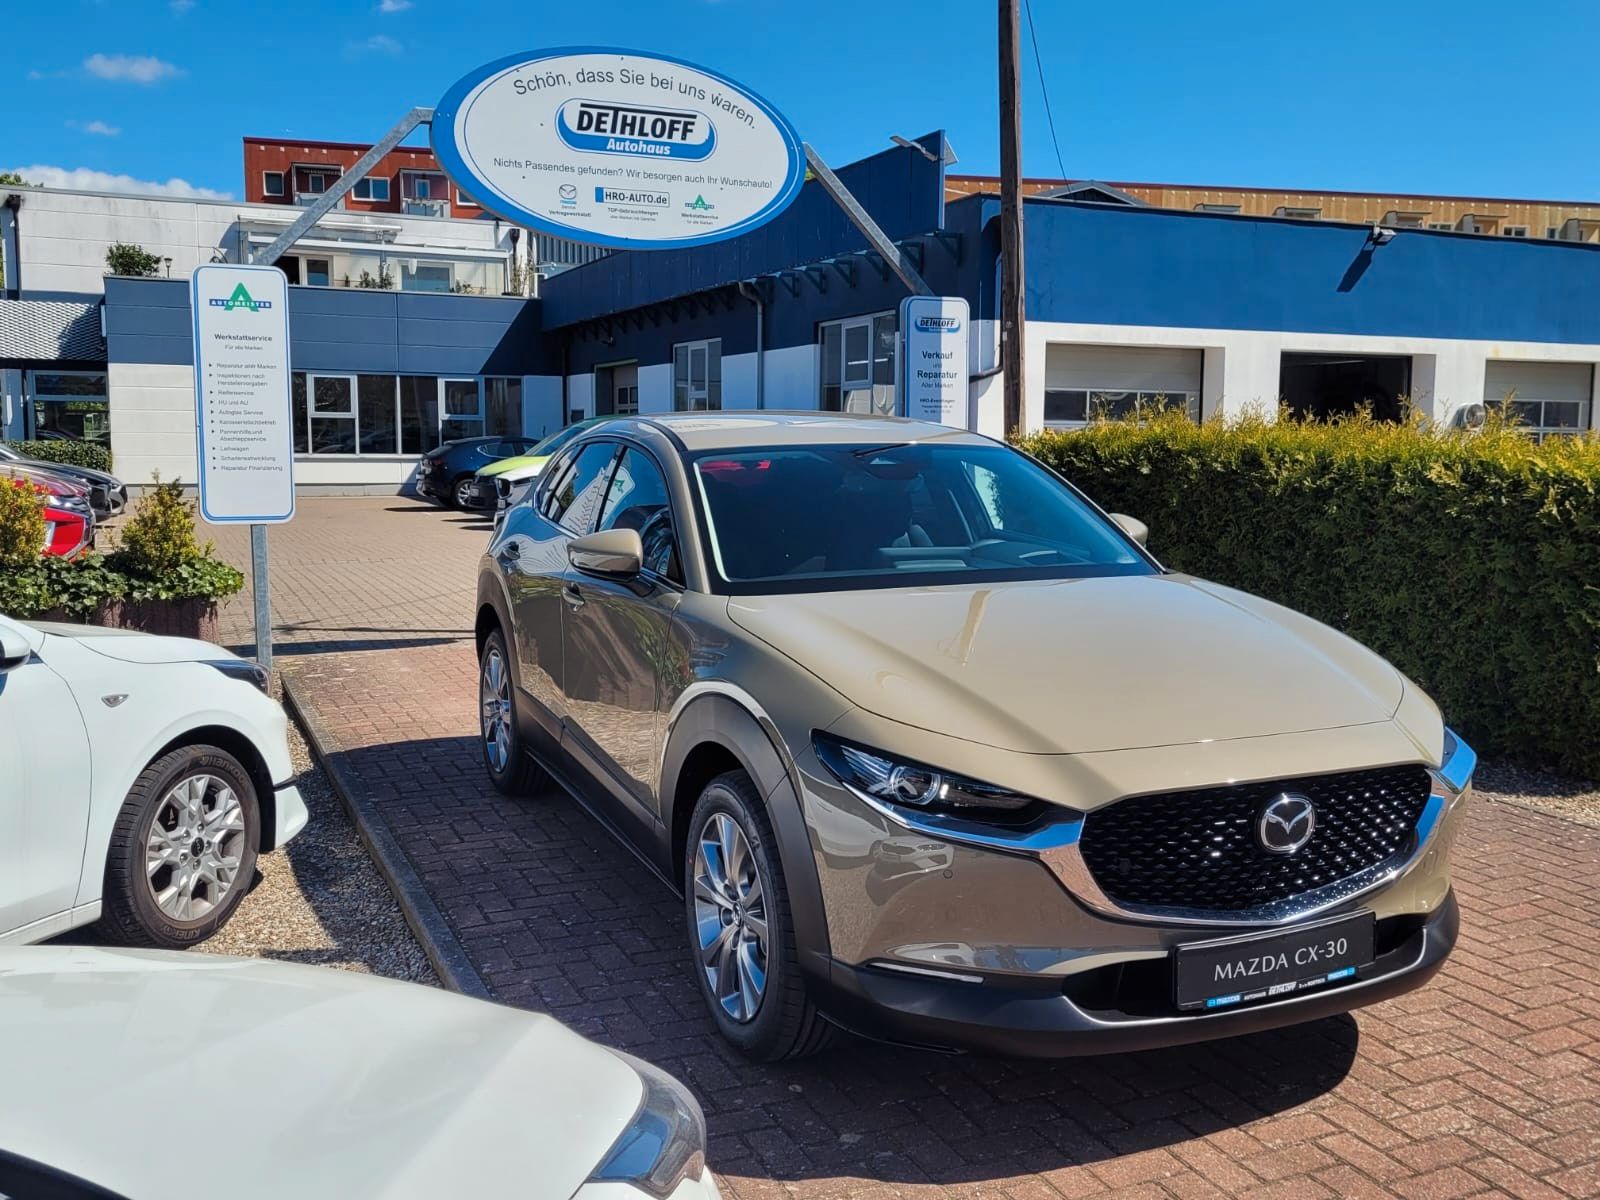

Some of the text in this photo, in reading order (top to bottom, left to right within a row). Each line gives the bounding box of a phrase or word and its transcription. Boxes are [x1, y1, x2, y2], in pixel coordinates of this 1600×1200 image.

[513, 68, 755, 129] Schön, dass Sie bei uns waren.
[577, 103, 697, 141] DETHLOFF
[606, 138, 671, 155] Autohaus
[493, 158, 772, 189] Nichts Passendes gefunden? Wir besorgen auch Ihr Wunschauto!
[605, 191, 667, 205] HRO-AUTO.de
[210, 299, 271, 308] AUTOMEISTER
[920, 317, 956, 327] DETHLOFF
[214, 333, 273, 342] Werkstattservice
[921, 350, 953, 360] Verkauf
[917, 369, 958, 380] Reparatur
[1214, 937, 1348, 981] MAZDA CX-30
